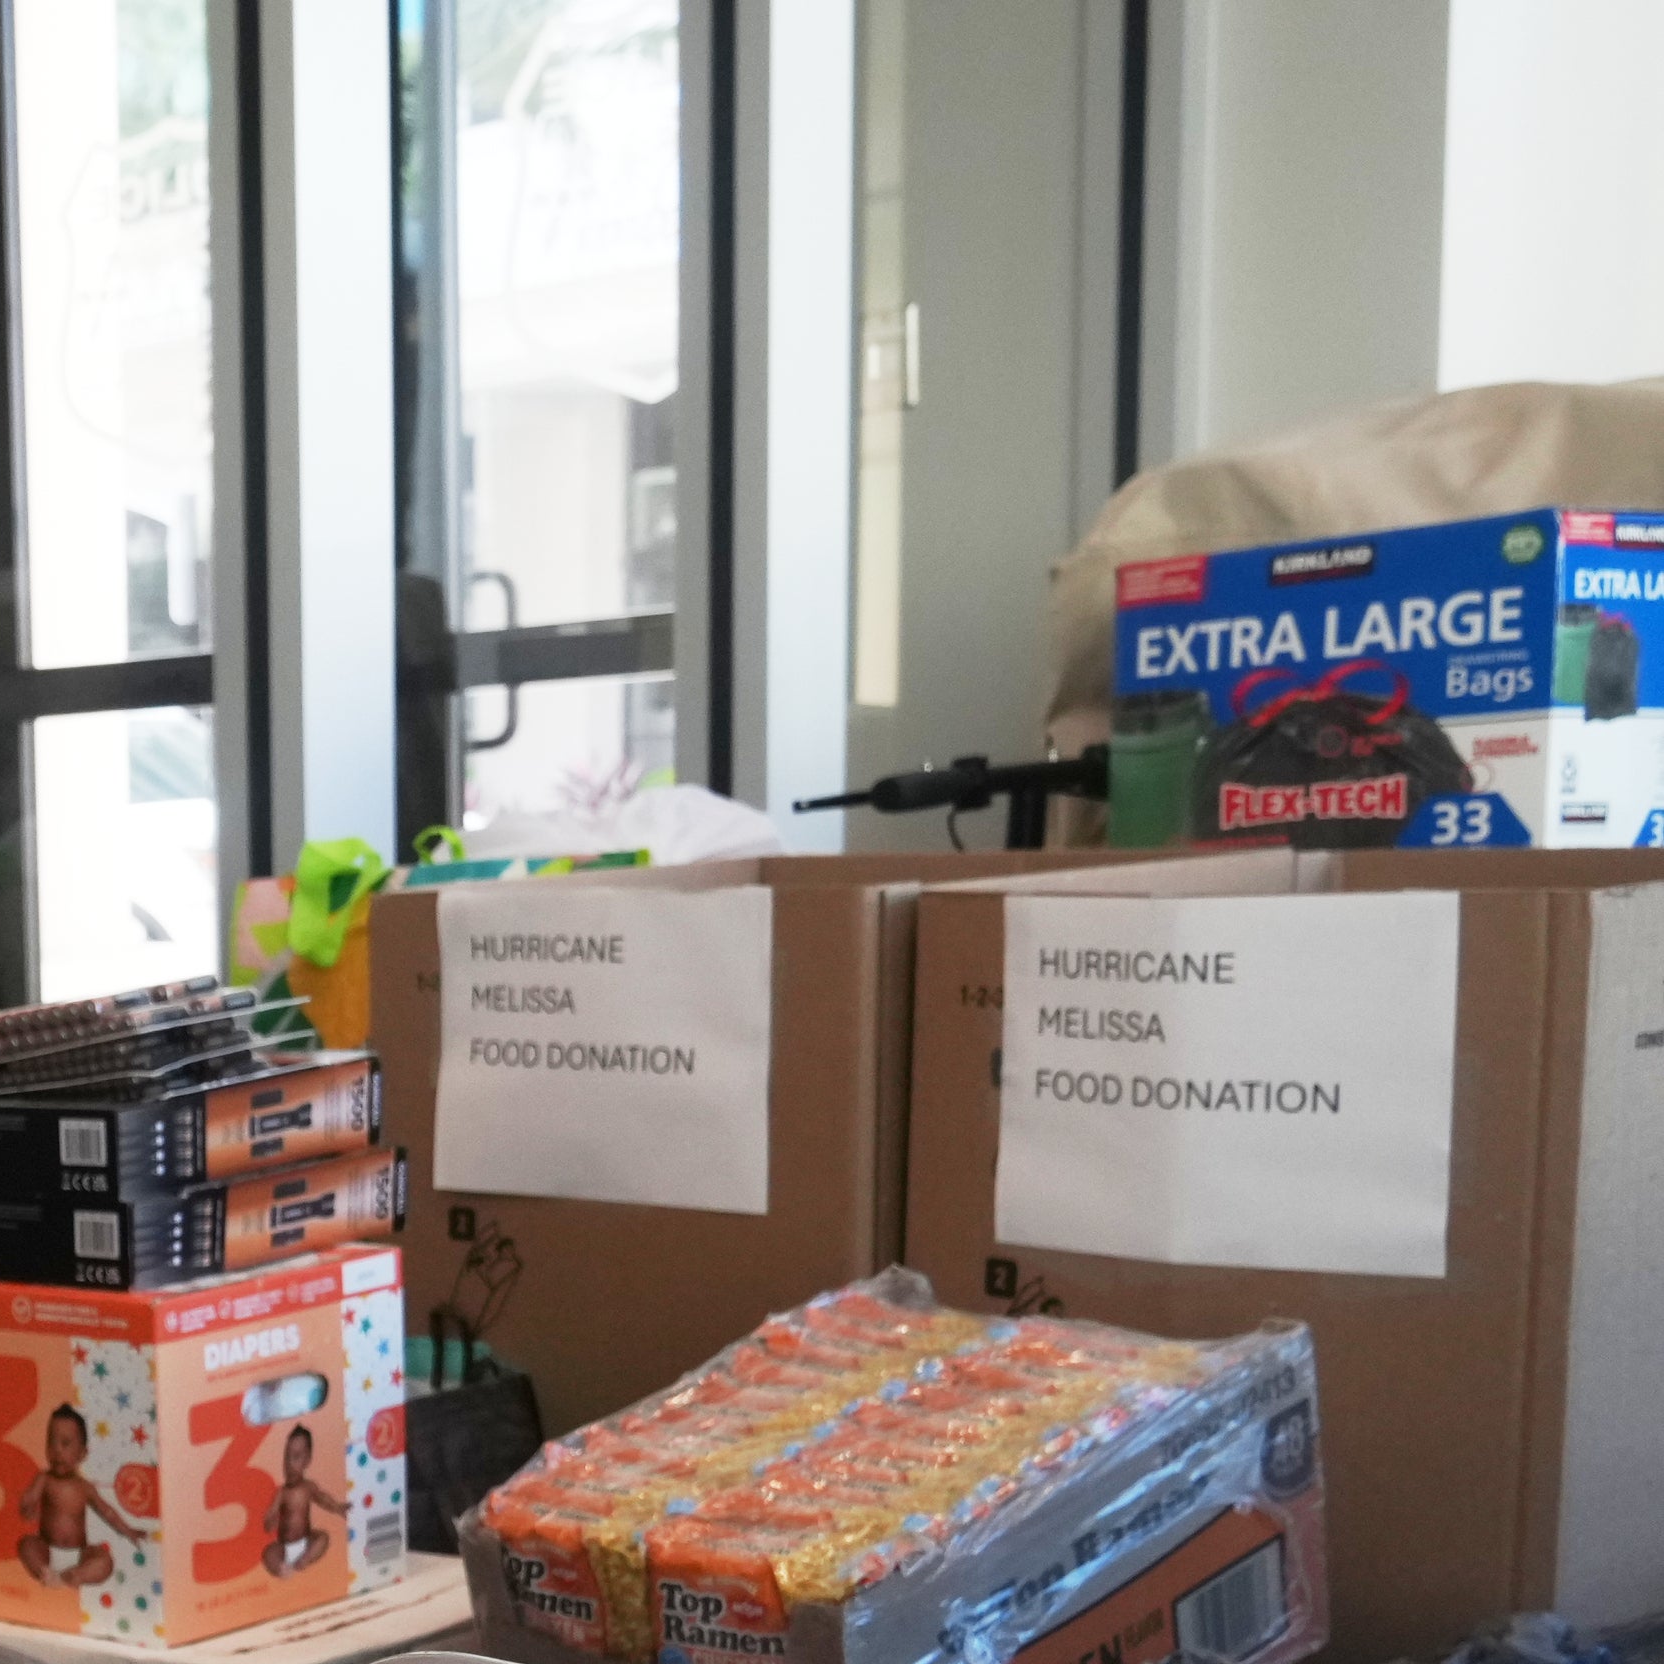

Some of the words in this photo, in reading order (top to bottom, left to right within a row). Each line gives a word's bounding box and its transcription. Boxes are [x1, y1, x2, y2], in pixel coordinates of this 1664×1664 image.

[1137, 611, 1306, 679] EXTRA
[1324, 587, 1525, 658] LARGE
[1445, 661, 1534, 701] Bags
[1220, 774, 1407, 830] FLEX-TECH
[1431, 800, 1491, 846] 33
[470, 935, 625, 964] HURRICANE
[1038, 947, 1236, 985] HURRICANE
[471, 986, 575, 1014] MELISSA
[1038, 1006, 1166, 1044] MELISSA
[468, 1039, 541, 1070] FOOD
[546, 1042, 696, 1075] DONATION
[1034, 1070, 1122, 1106] FOOD
[1131, 1078, 1341, 1114] DONATION
[203, 1323, 301, 1372] DIAPERS
[188, 1394, 277, 1585] 3
[660, 1582, 723, 1624] Top
[663, 1614, 785, 1656] Ramen
